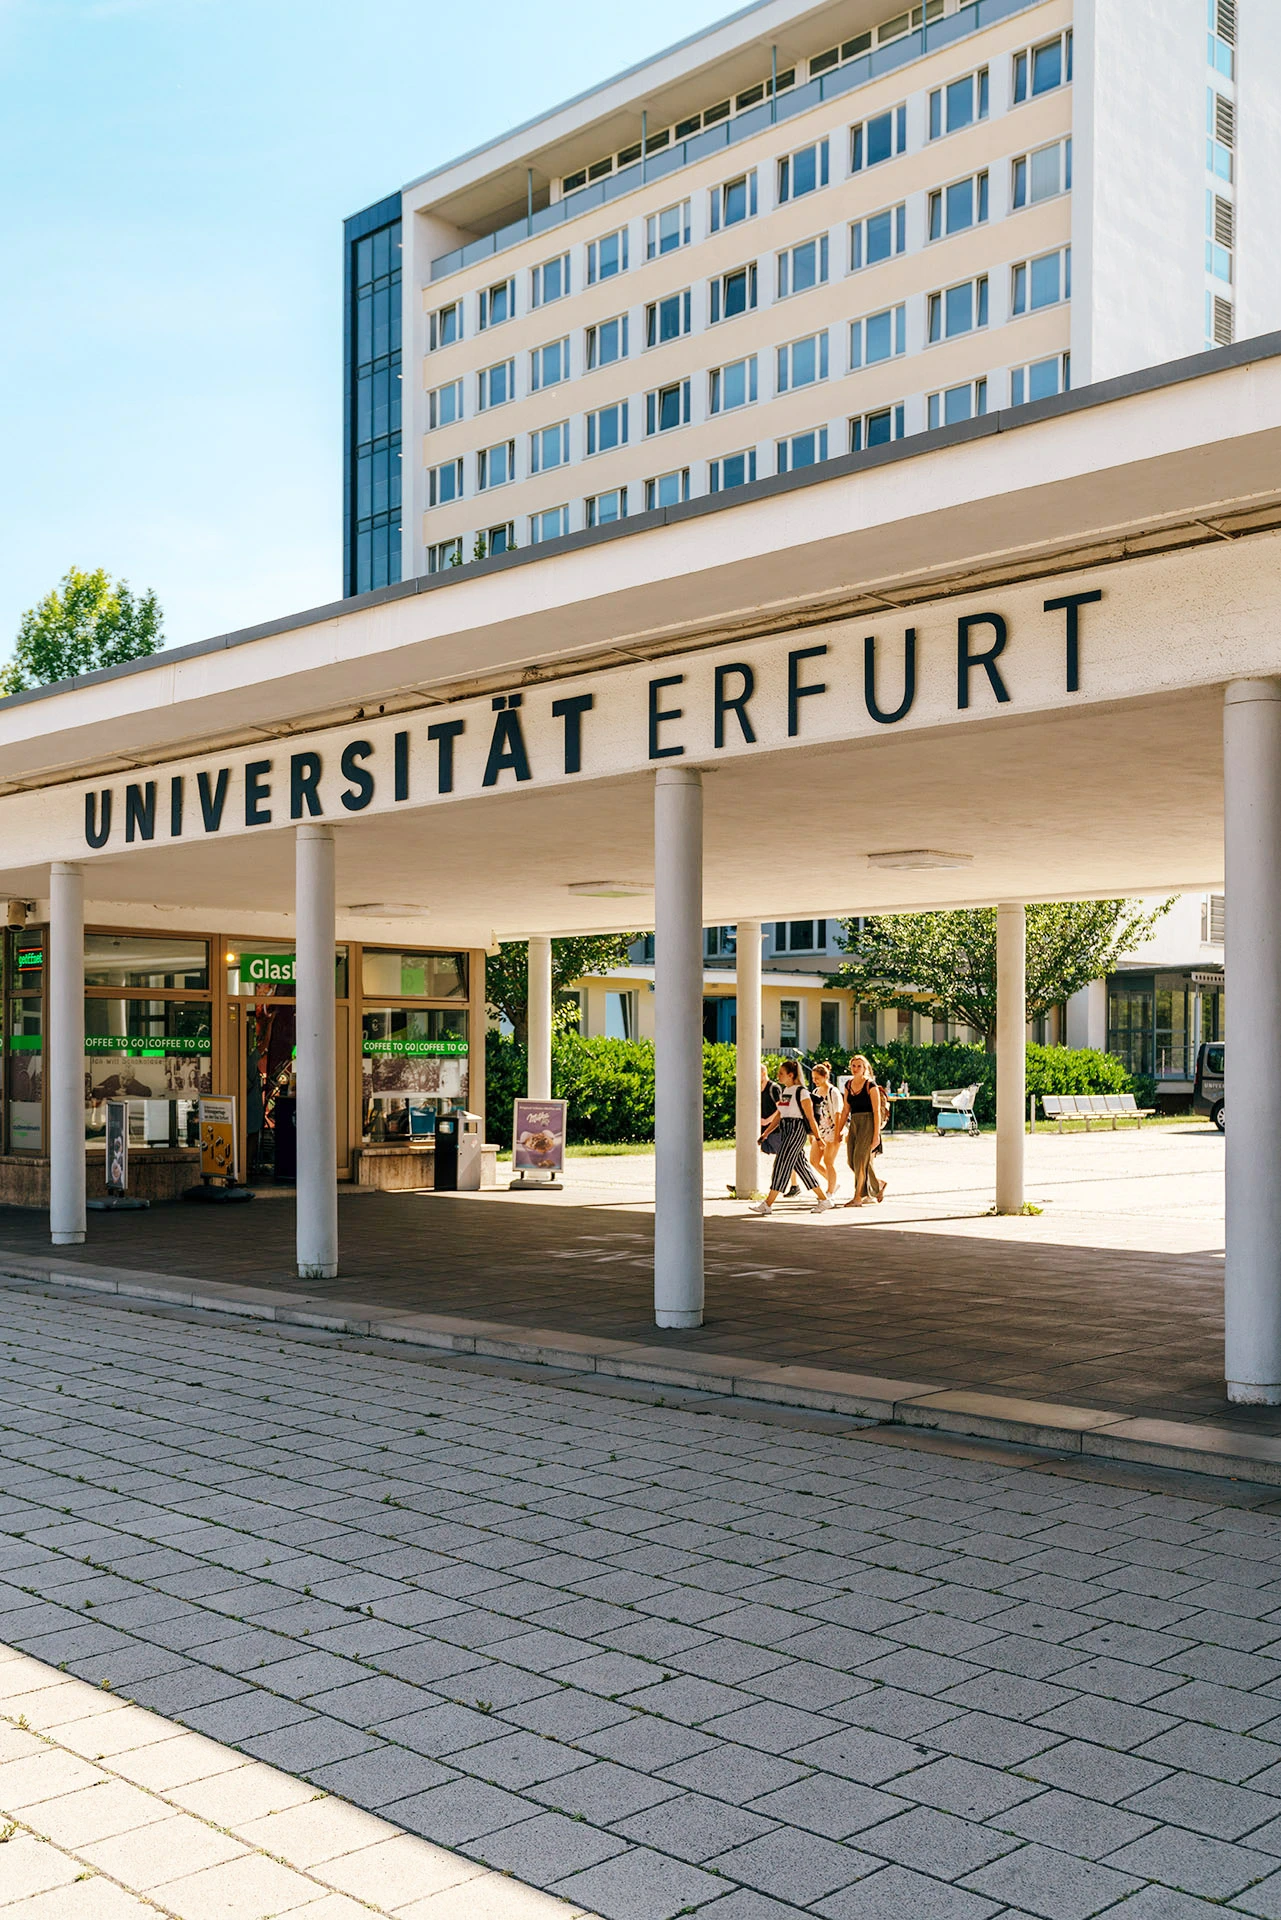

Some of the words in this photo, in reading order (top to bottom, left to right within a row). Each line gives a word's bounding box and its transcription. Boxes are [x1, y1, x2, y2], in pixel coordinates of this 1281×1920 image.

[85, 693, 593, 849] UNIVERSITÄT
[648, 589, 1102, 760] ERFURT
[83, 1037, 113, 1048] OFFEE
[116, 1038, 128, 1048] TO
[131, 1038, 144, 1048] GO
[149, 1038, 181, 1048] COFFEE
[184, 1039, 195, 1049] TO
[198, 1039, 211, 1049] GO
[363, 1042, 391, 1051] COFFEE
[393, 1042, 403, 1051] TO
[405, 1042, 416, 1051] GO
[419, 1043, 445, 1051] COFFEE
[447, 1043, 457, 1052] TO
[458, 1043, 469, 1052] GO
